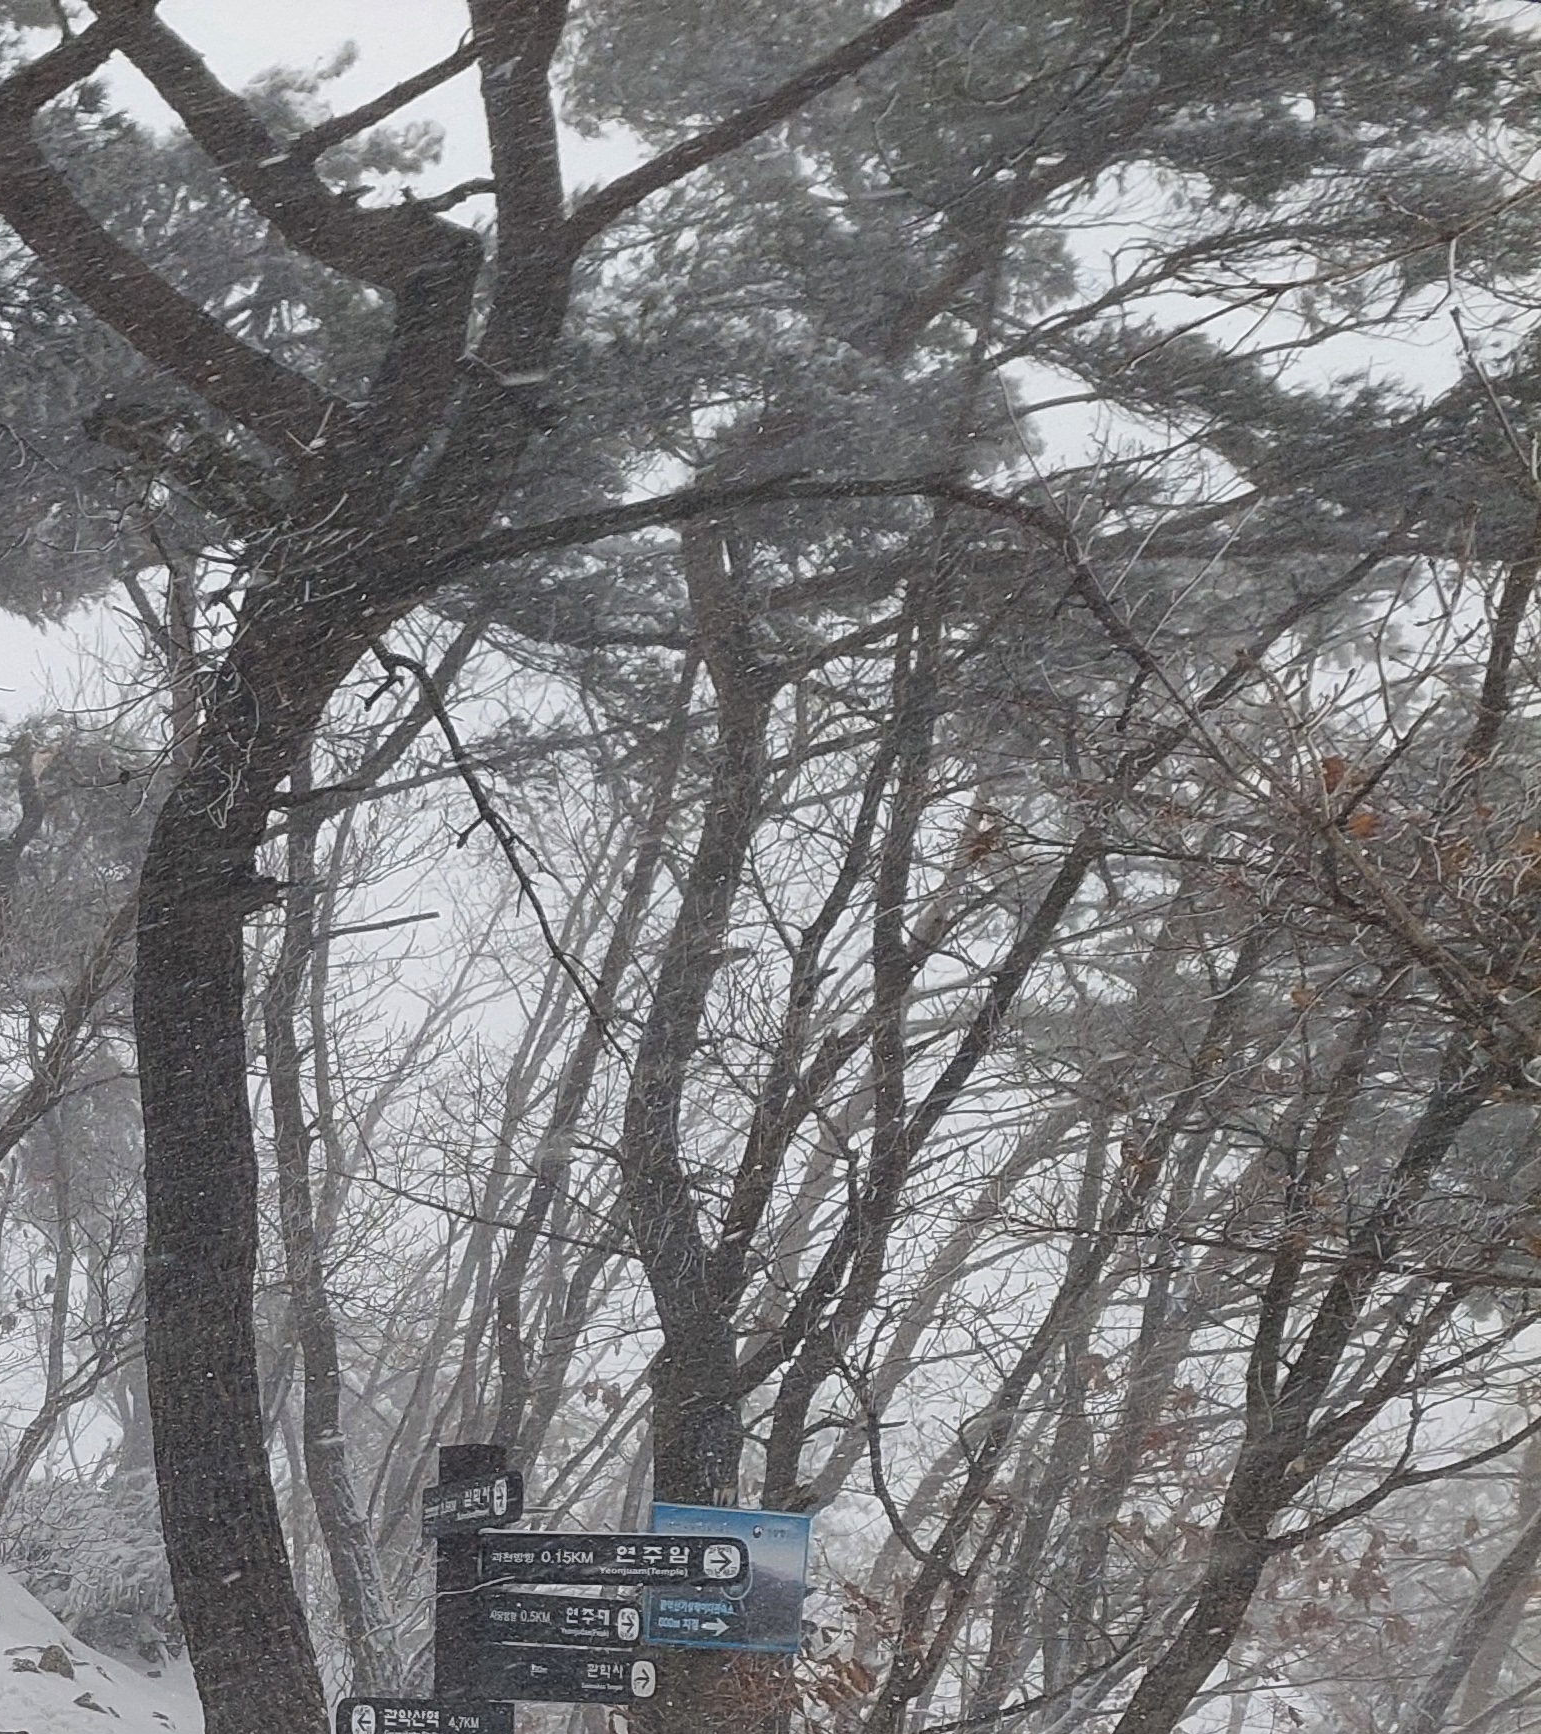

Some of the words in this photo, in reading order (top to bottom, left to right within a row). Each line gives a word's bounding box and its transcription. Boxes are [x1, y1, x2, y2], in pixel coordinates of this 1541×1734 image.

[540, 1550, 594, 1565] 0.15KM
[616, 1545, 691, 1564] 연주암
[565, 1606, 610, 1626] 연주대
[384, 1708, 440, 1728] 관악산역
